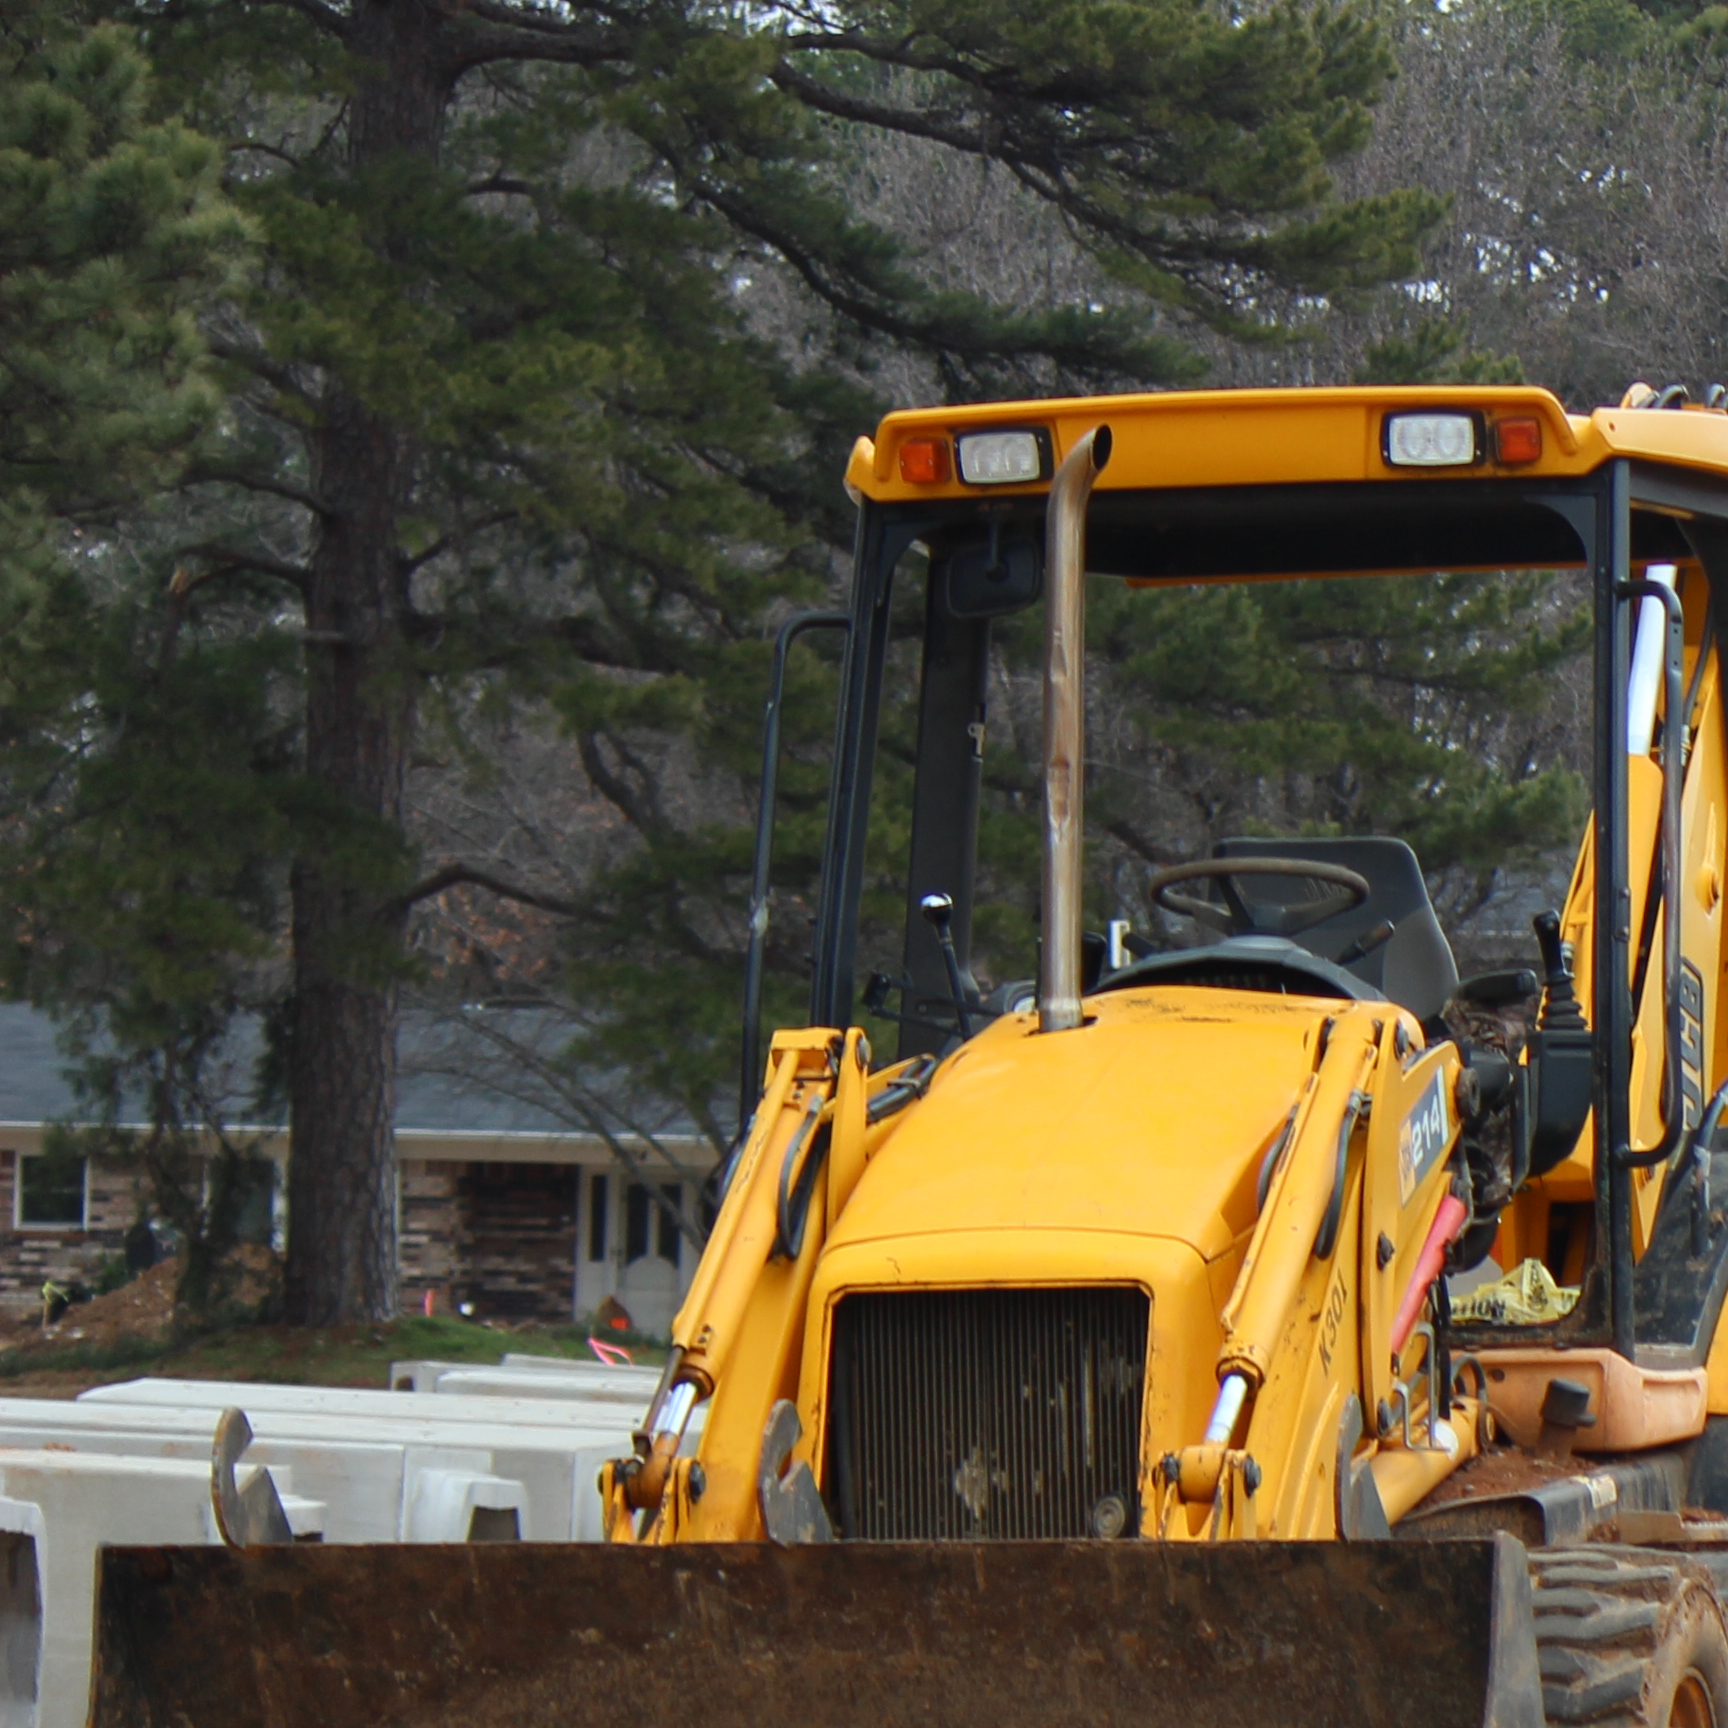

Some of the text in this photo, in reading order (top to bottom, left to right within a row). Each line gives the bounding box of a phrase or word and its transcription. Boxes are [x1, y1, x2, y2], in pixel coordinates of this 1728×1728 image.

[1680, 968, 1702, 1132] JCB
[1412, 1094, 1440, 1169] 214
[1318, 1267, 1348, 1379] K301
